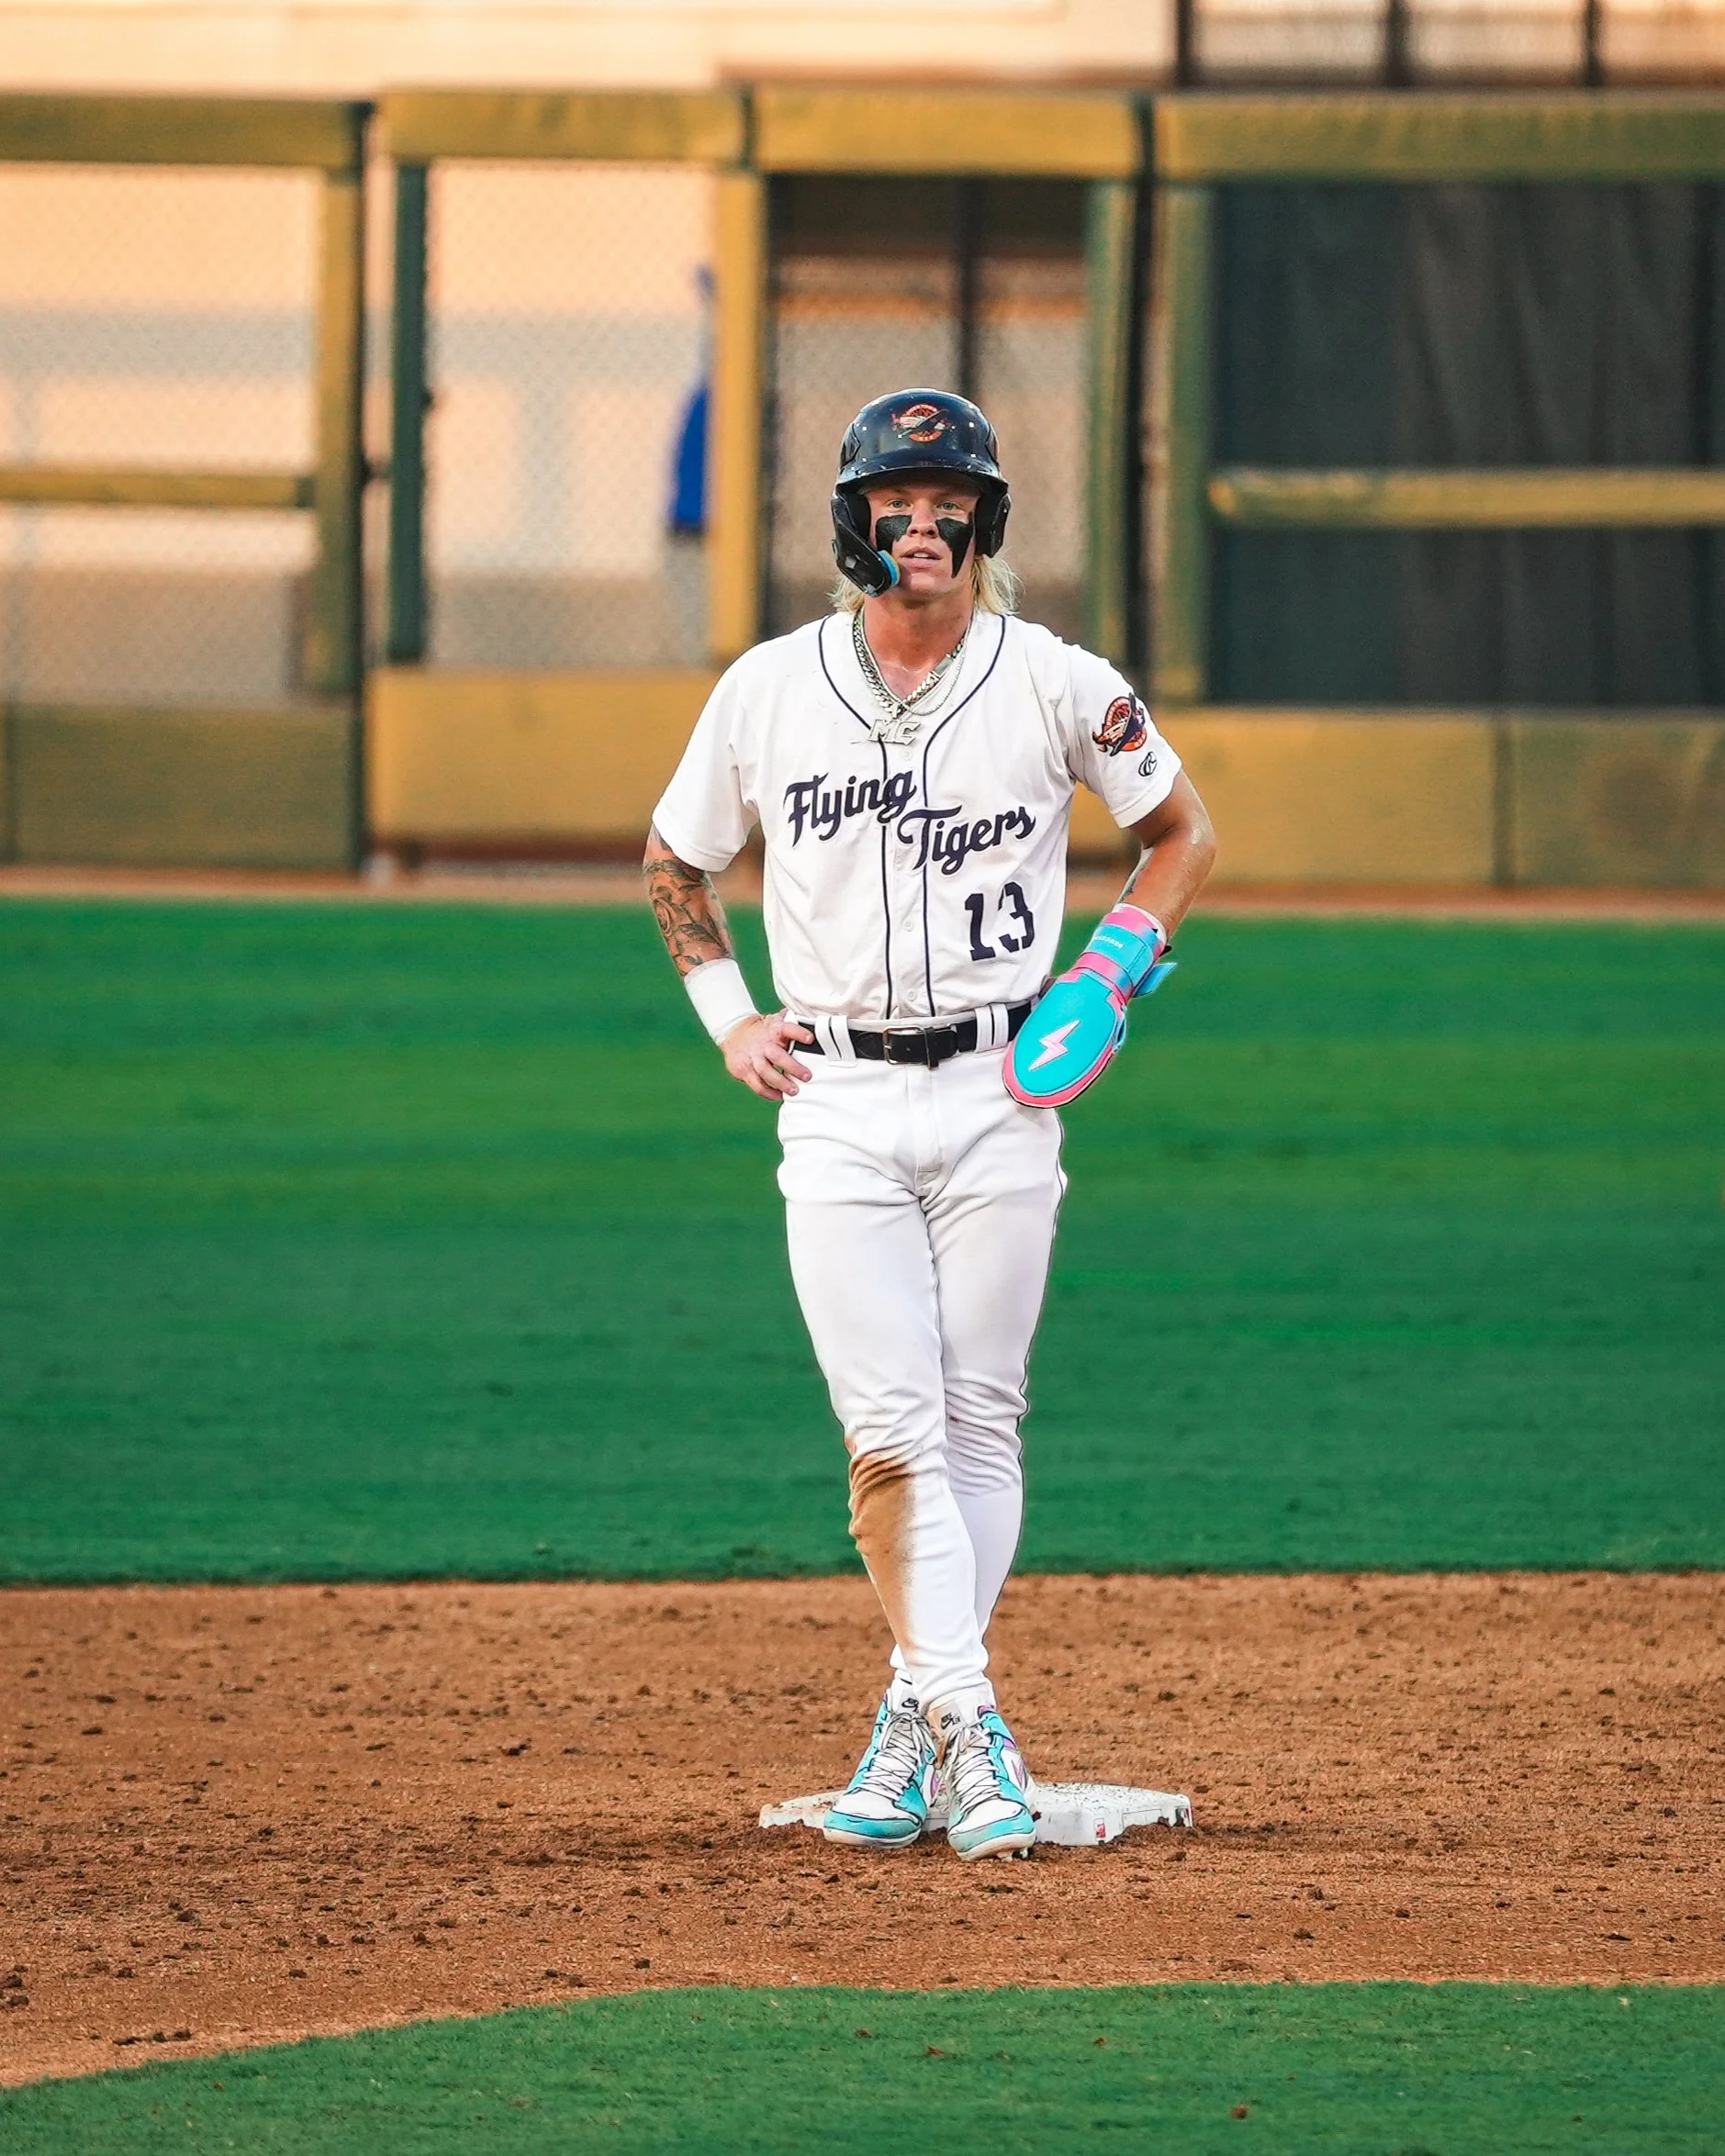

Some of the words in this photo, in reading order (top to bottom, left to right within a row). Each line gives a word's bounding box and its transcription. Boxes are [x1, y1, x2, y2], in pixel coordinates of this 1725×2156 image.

[868, 719, 921, 745] MC
[783, 770, 917, 847] Flying
[897, 805, 1036, 876] Tigers
[965, 882, 1035, 961] 13
